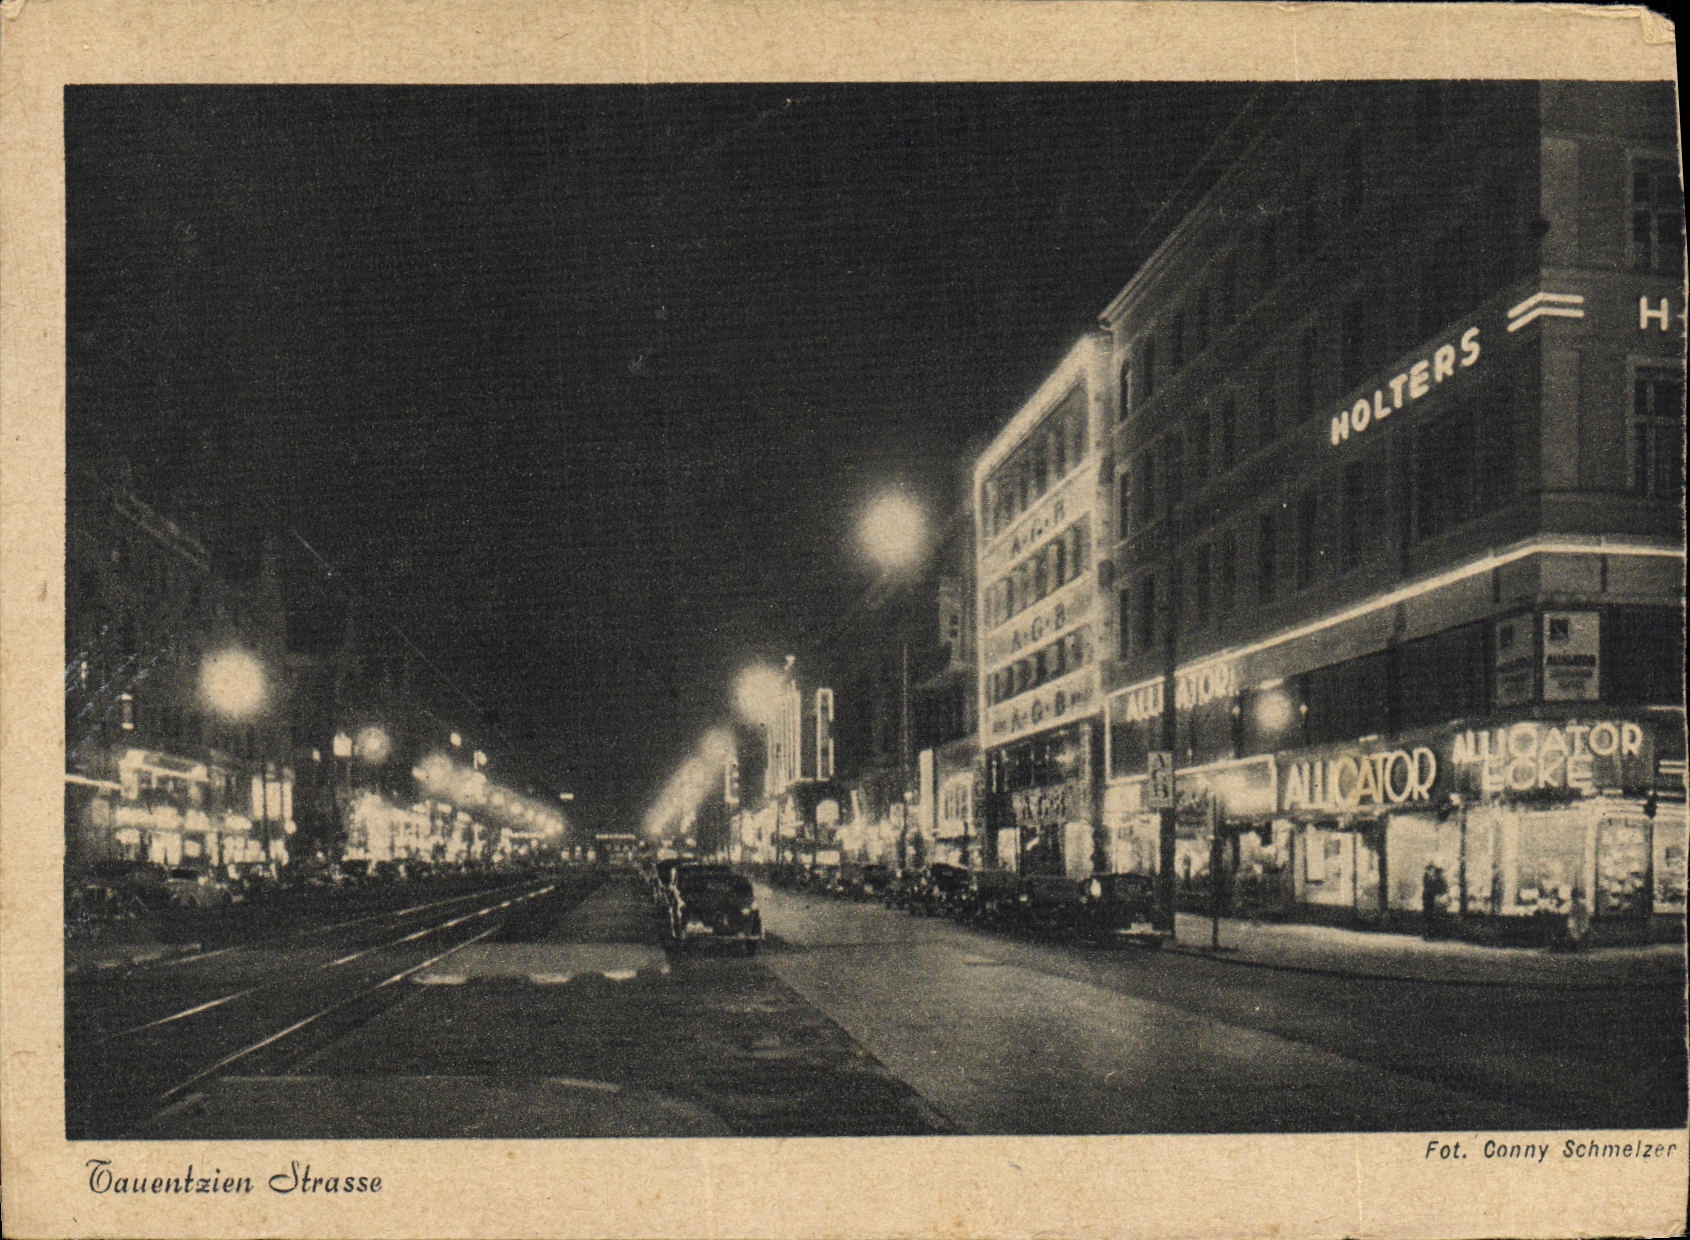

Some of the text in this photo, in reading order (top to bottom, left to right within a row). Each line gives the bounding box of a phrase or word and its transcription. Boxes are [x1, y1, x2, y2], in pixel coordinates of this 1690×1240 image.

[1640, 296, 1687, 331] H
[1331, 326, 1480, 445] HOLTERS
[1126, 662, 1240, 722] ALLIATOR
